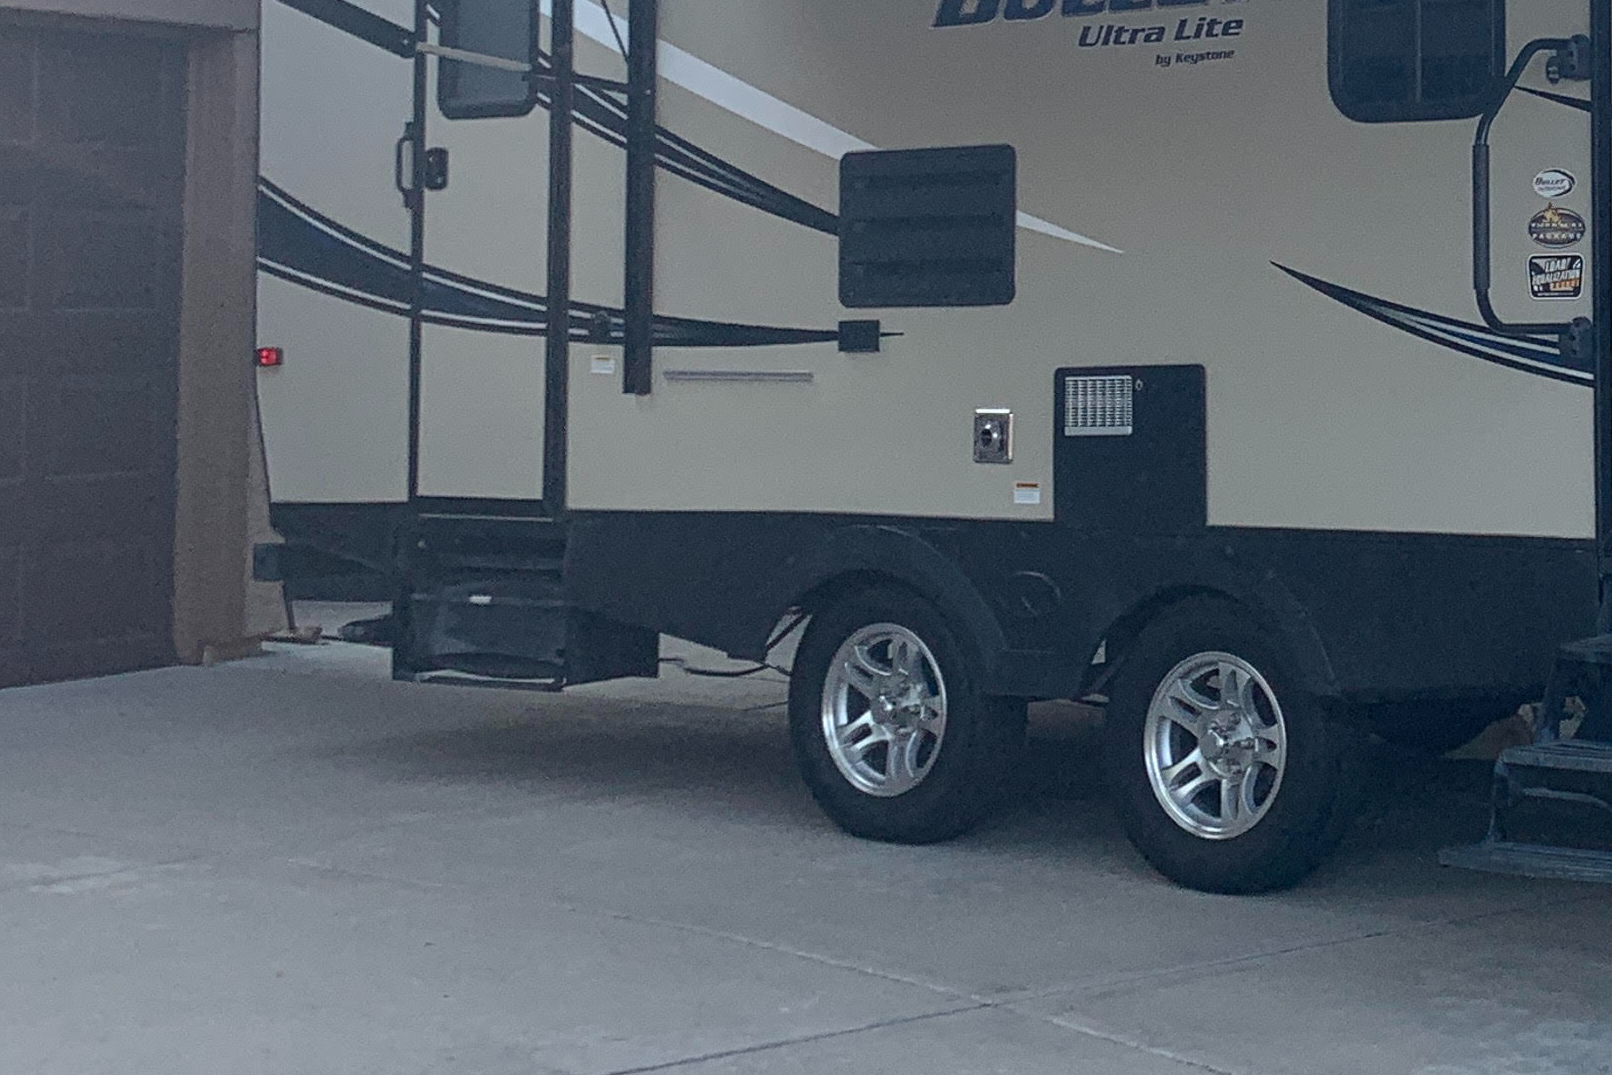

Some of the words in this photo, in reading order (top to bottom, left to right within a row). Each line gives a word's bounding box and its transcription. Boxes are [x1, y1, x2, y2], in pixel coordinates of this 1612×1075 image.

[1078, 25, 1166, 47] Ultra
[1174, 17, 1244, 41] Lite
[1155, 54, 1171, 67] by
[1175, 50, 1235, 65] Keystone
